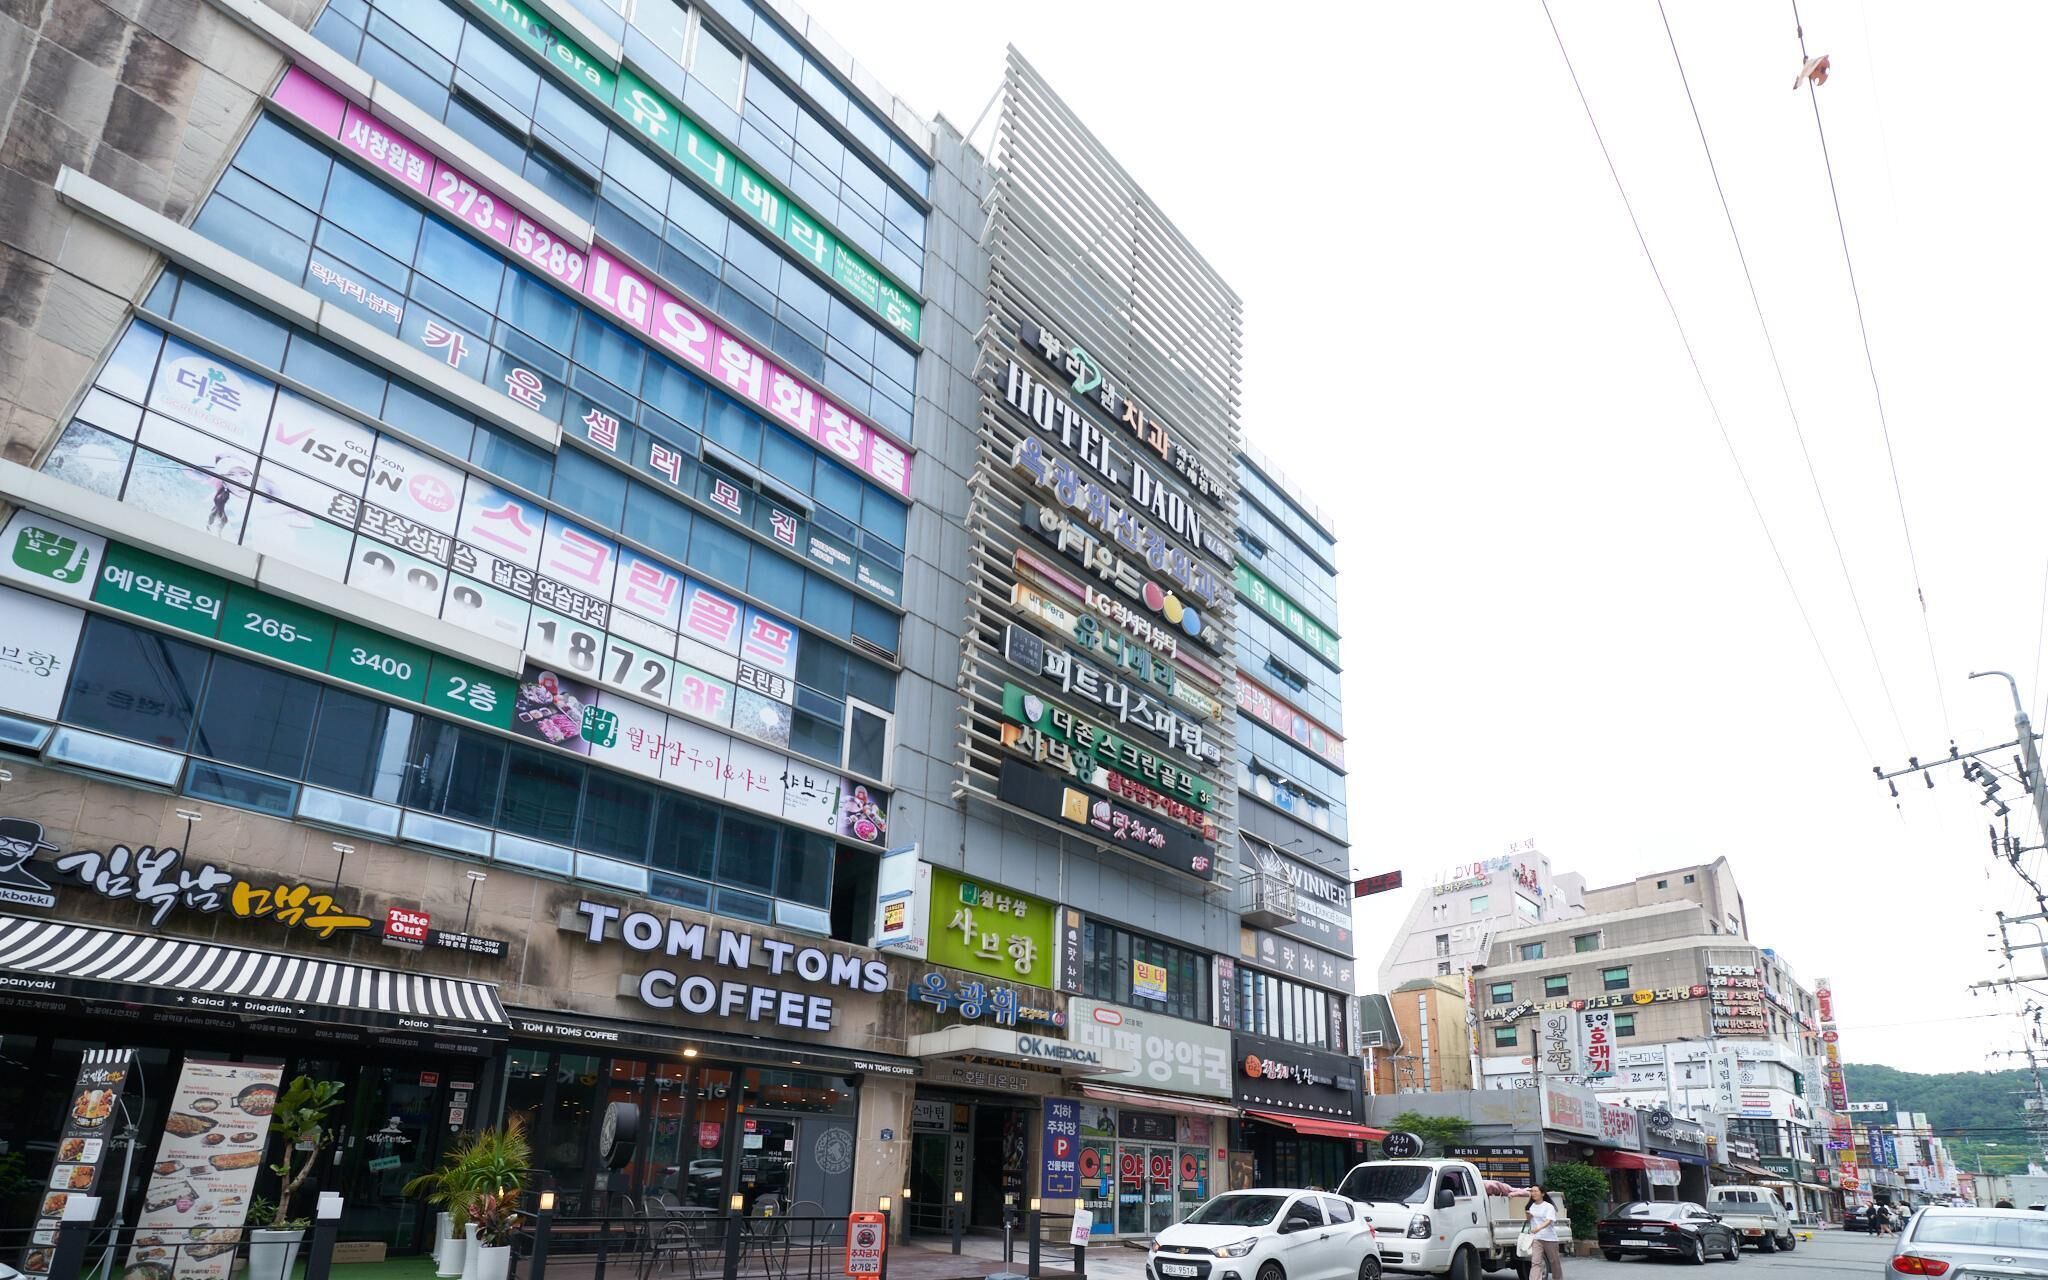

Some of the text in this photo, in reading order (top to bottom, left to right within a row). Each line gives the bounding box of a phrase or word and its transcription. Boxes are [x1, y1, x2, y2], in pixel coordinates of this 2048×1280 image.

[348, 117, 428, 182] 서창원점
[623, 88, 828, 264] 유니베라
[885, 301, 913, 332] 5F
[1121, 396, 1170, 461] 치과
[1005, 358, 1118, 485] HOTEL
[1131, 460, 1201, 549] DAON
[103, 564, 221, 620] 예약문의
[1073, 612, 1176, 696] 유니베라
[446, 676, 498, 713] 2층
[1285, 862, 1348, 909] WINNER
[389, 909, 429, 927] Take
[979, 889, 1028, 919] 월남쌈
[391, 921, 423, 937] Out
[578, 900, 889, 993] TOM N TOMS
[947, 907, 1038, 975] 샤브향
[191, 995, 292, 1015] Salad Driedfish
[638, 968, 833, 1031] COFFEE
[919, 972, 1017, 1027] 옥광휘
[399, 1017, 430, 1029] Potato
[521, 1021, 619, 1042] TOM N TOMS COFFEE
[1584, 1013, 1609, 1028] 통영
[1018, 1035, 1101, 1064] OK MEDICAL
[1588, 1027, 1611, 1073] 호래기
[853, 1061, 868, 1071] TOM
[874, 1063, 892, 1073] TOMS
[892, 1066, 914, 1075] COFFEE
[1047, 1120, 1077, 1137] 주차장
[1053, 1103, 1072, 1119] 지하
[1057, 1139, 1068, 1156] P
[1121, 1153, 1144, 1190] 약
[1151, 1155, 1173, 1191] 약
